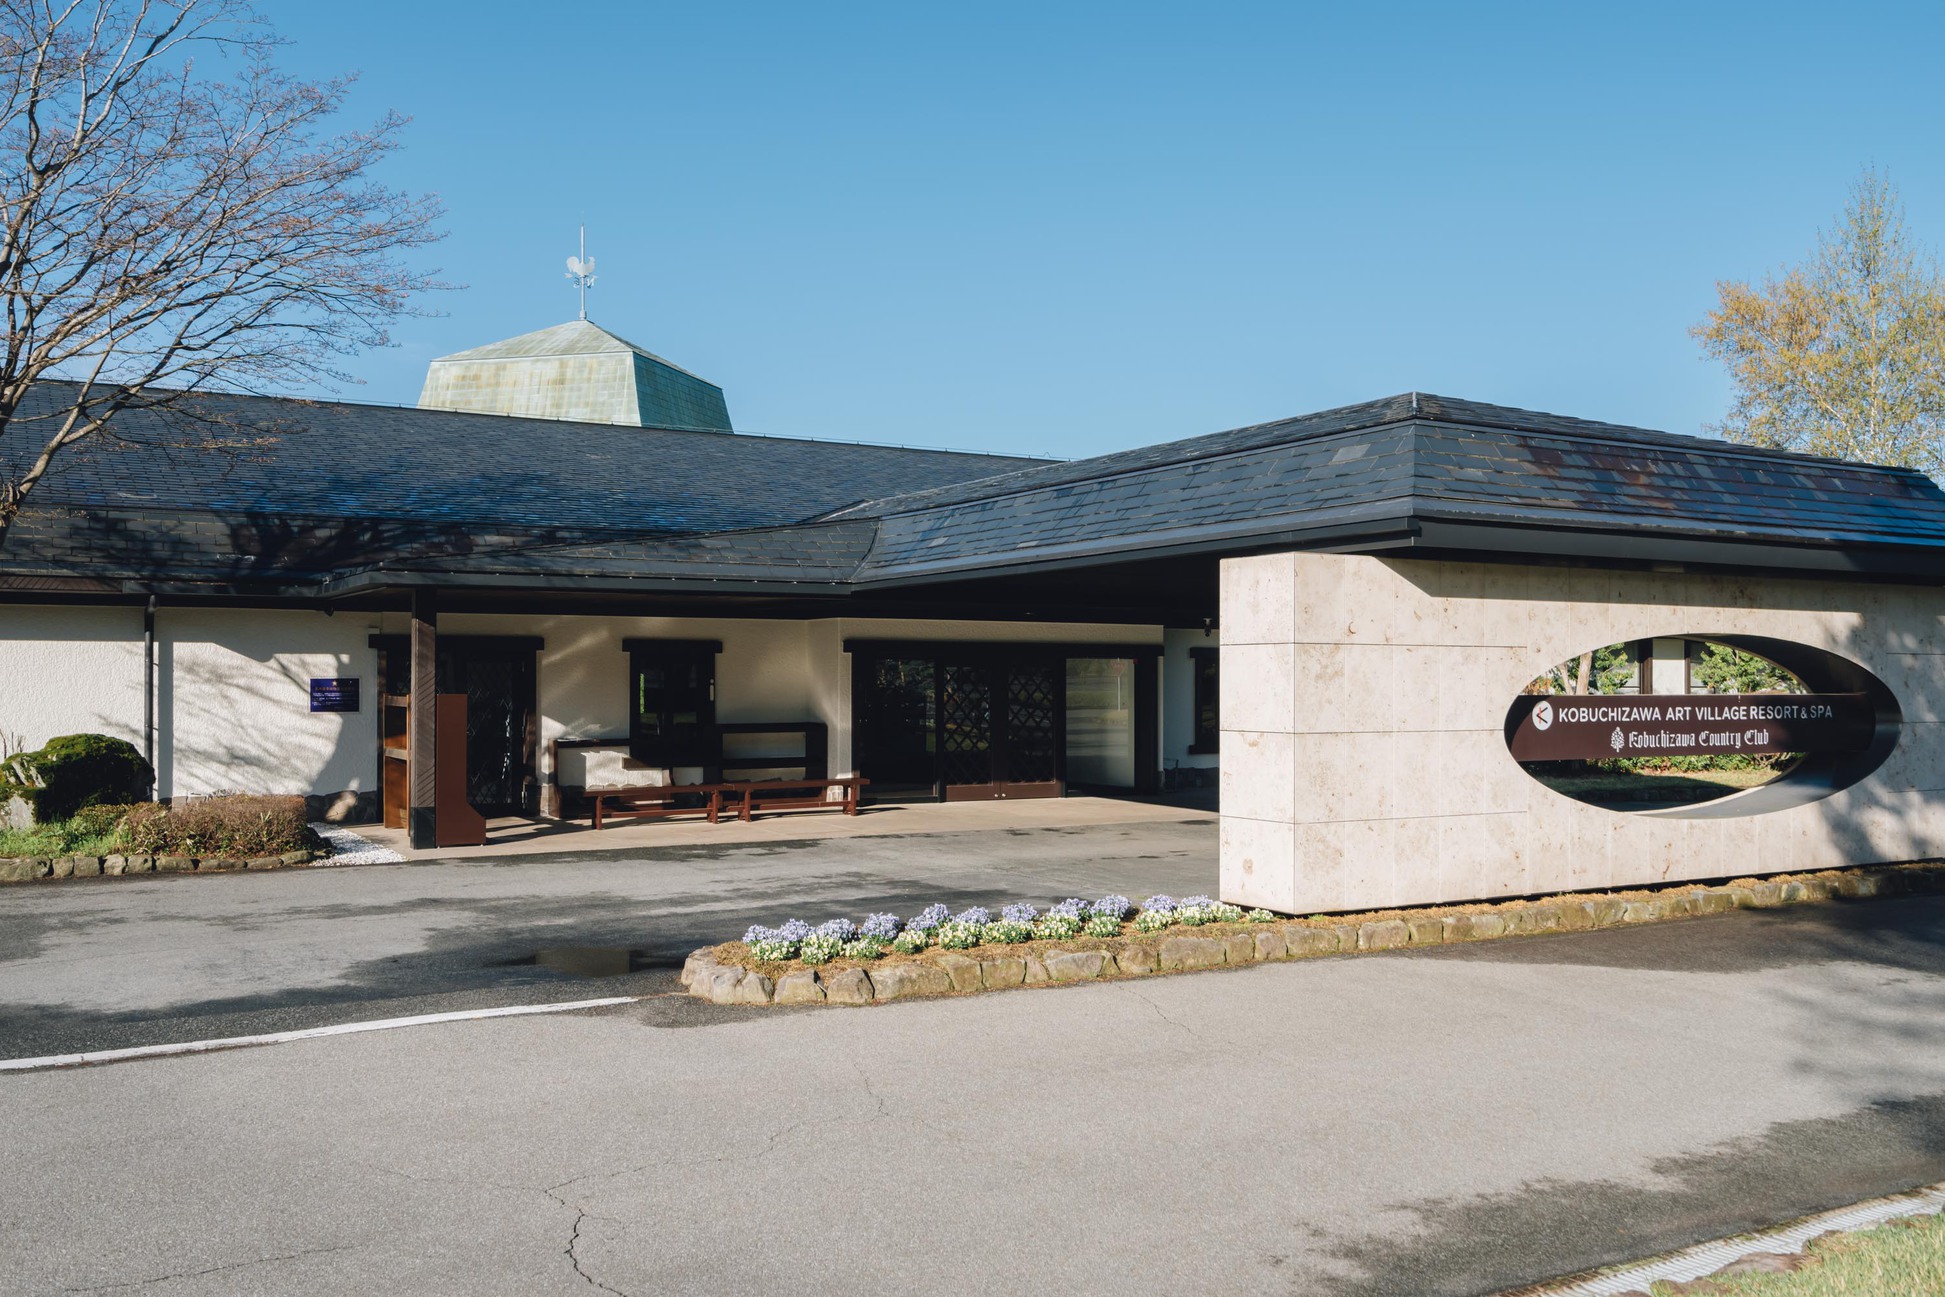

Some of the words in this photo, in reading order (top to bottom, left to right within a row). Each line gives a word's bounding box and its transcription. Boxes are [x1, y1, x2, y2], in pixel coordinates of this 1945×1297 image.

[1559, 707, 1661, 722] KOBUCHIZAWA
[1666, 707, 1691, 720] ART
[1696, 706, 1747, 720] VILLAGE
[1750, 705, 1799, 719] RESORT
[1801, 706, 1808, 719] &
[1810, 705, 1833, 718] SPA
[1699, 731, 1741, 748] Country
[1744, 729, 1769, 745] Club
